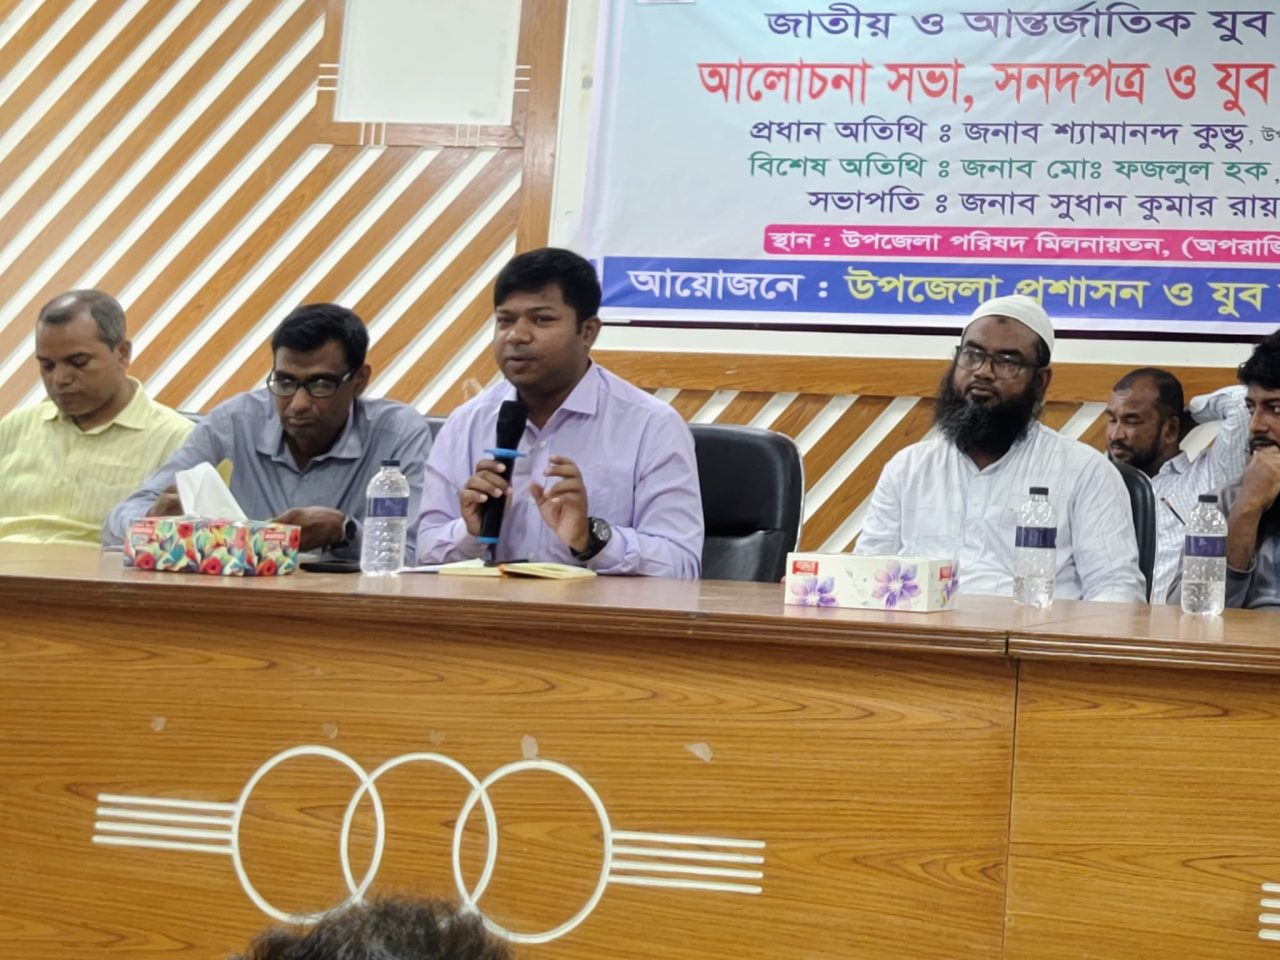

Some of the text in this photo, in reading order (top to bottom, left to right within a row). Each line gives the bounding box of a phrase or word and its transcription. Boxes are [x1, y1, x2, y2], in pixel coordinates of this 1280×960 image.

[764, 2, 898, 39] জাতীয়
[911, 13, 944, 36] ও
[960, 1, 1197, 39] আন্তর্জাতিক
[1207, 10, 1275, 45] যুব
[696, 57, 873, 105] আলোচনা
[883, 58, 974, 113] সভা,
[991, 57, 1151, 106] সনদপত্র
[1166, 64, 1196, 101] ও
[1213, 63, 1277, 117] যুব
[749, 120, 825, 143] প্রধান
[834, 115, 928, 144] অতিথি
[962, 121, 1043, 145] জনাব
[1051, 120, 1183, 145] শ্যামানন্দ
[748, 151, 831, 177] বিশেষ
[838, 152, 928, 178] অতিথি
[960, 157, 1037, 179] জনাব
[1046, 158, 1102, 180] মোঃ
[1112, 159, 1215, 186] ফজলুল
[807, 185, 924, 214] সভাপতি
[958, 191, 1039, 215] জনাব
[1048, 192, 1127, 222] সুধান
[1135, 193, 1219, 222] কুমার
[768, 230, 815, 252] স্থান
[841, 229, 942, 251] উপজেলা
[949, 231, 1030, 253] পরিষদ
[1033, 231, 1169, 258] মিলনায়তন,
[627, 267, 805, 302] আয়োজনে
[844, 266, 1004, 304] উপজেলা
[1163, 283, 1194, 307] ও
[1208, 280, 1270, 318] যুব
